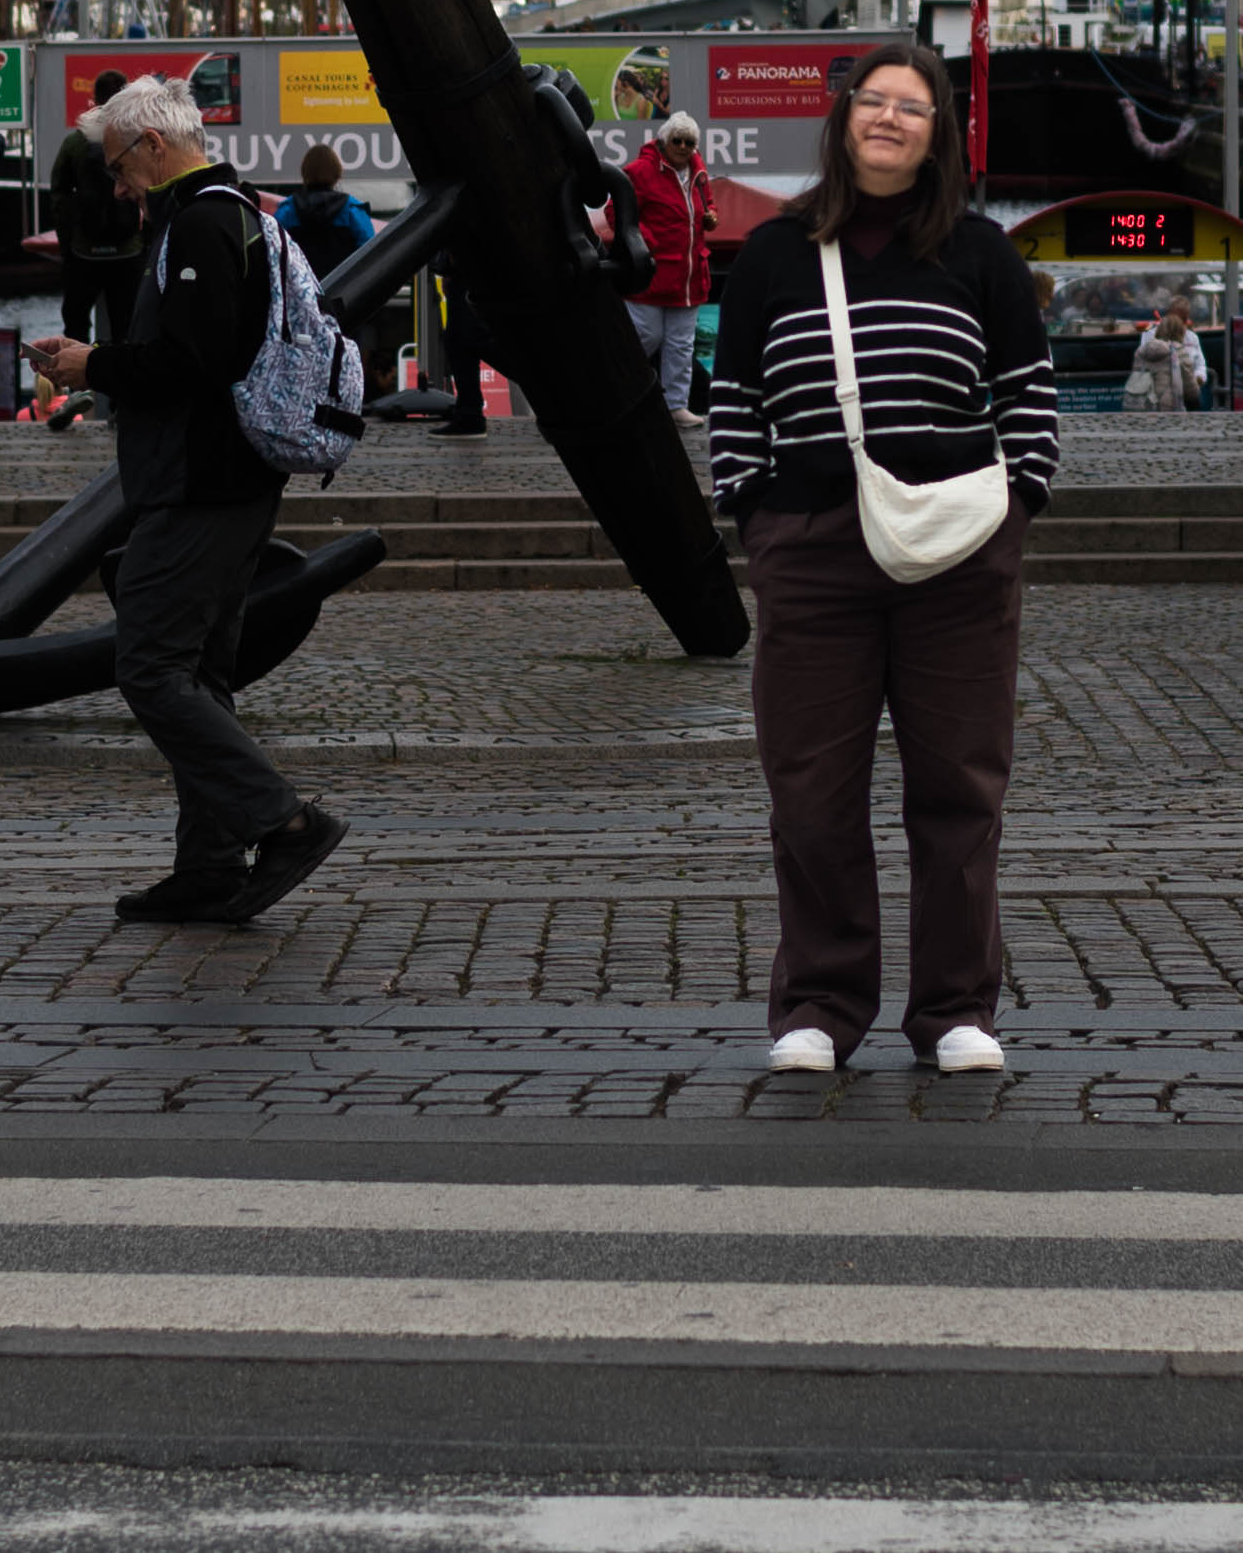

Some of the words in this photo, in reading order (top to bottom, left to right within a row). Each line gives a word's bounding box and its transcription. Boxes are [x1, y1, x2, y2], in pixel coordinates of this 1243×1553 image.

[286, 74, 320, 83] CANAL
[325, 74, 358, 82] TOURS
[737, 66, 821, 79] PANORAMA
[286, 83, 359, 92] COPENHAGEN
[717, 96, 782, 106] EXCURSIONS
[786, 95, 798, 104] BY
[802, 94, 821, 104] BUS
[204, 133, 291, 171] BUY
[304, 132, 411, 171] YOU
[1111, 214, 1145, 228] 14:00
[1156, 214, 1165, 228] 2
[1111, 233, 1145, 248] 14:30
[1160, 234, 1165, 247] 1
[1024, 237, 1040, 261] 2
[1220, 236, 1231, 261] 1
